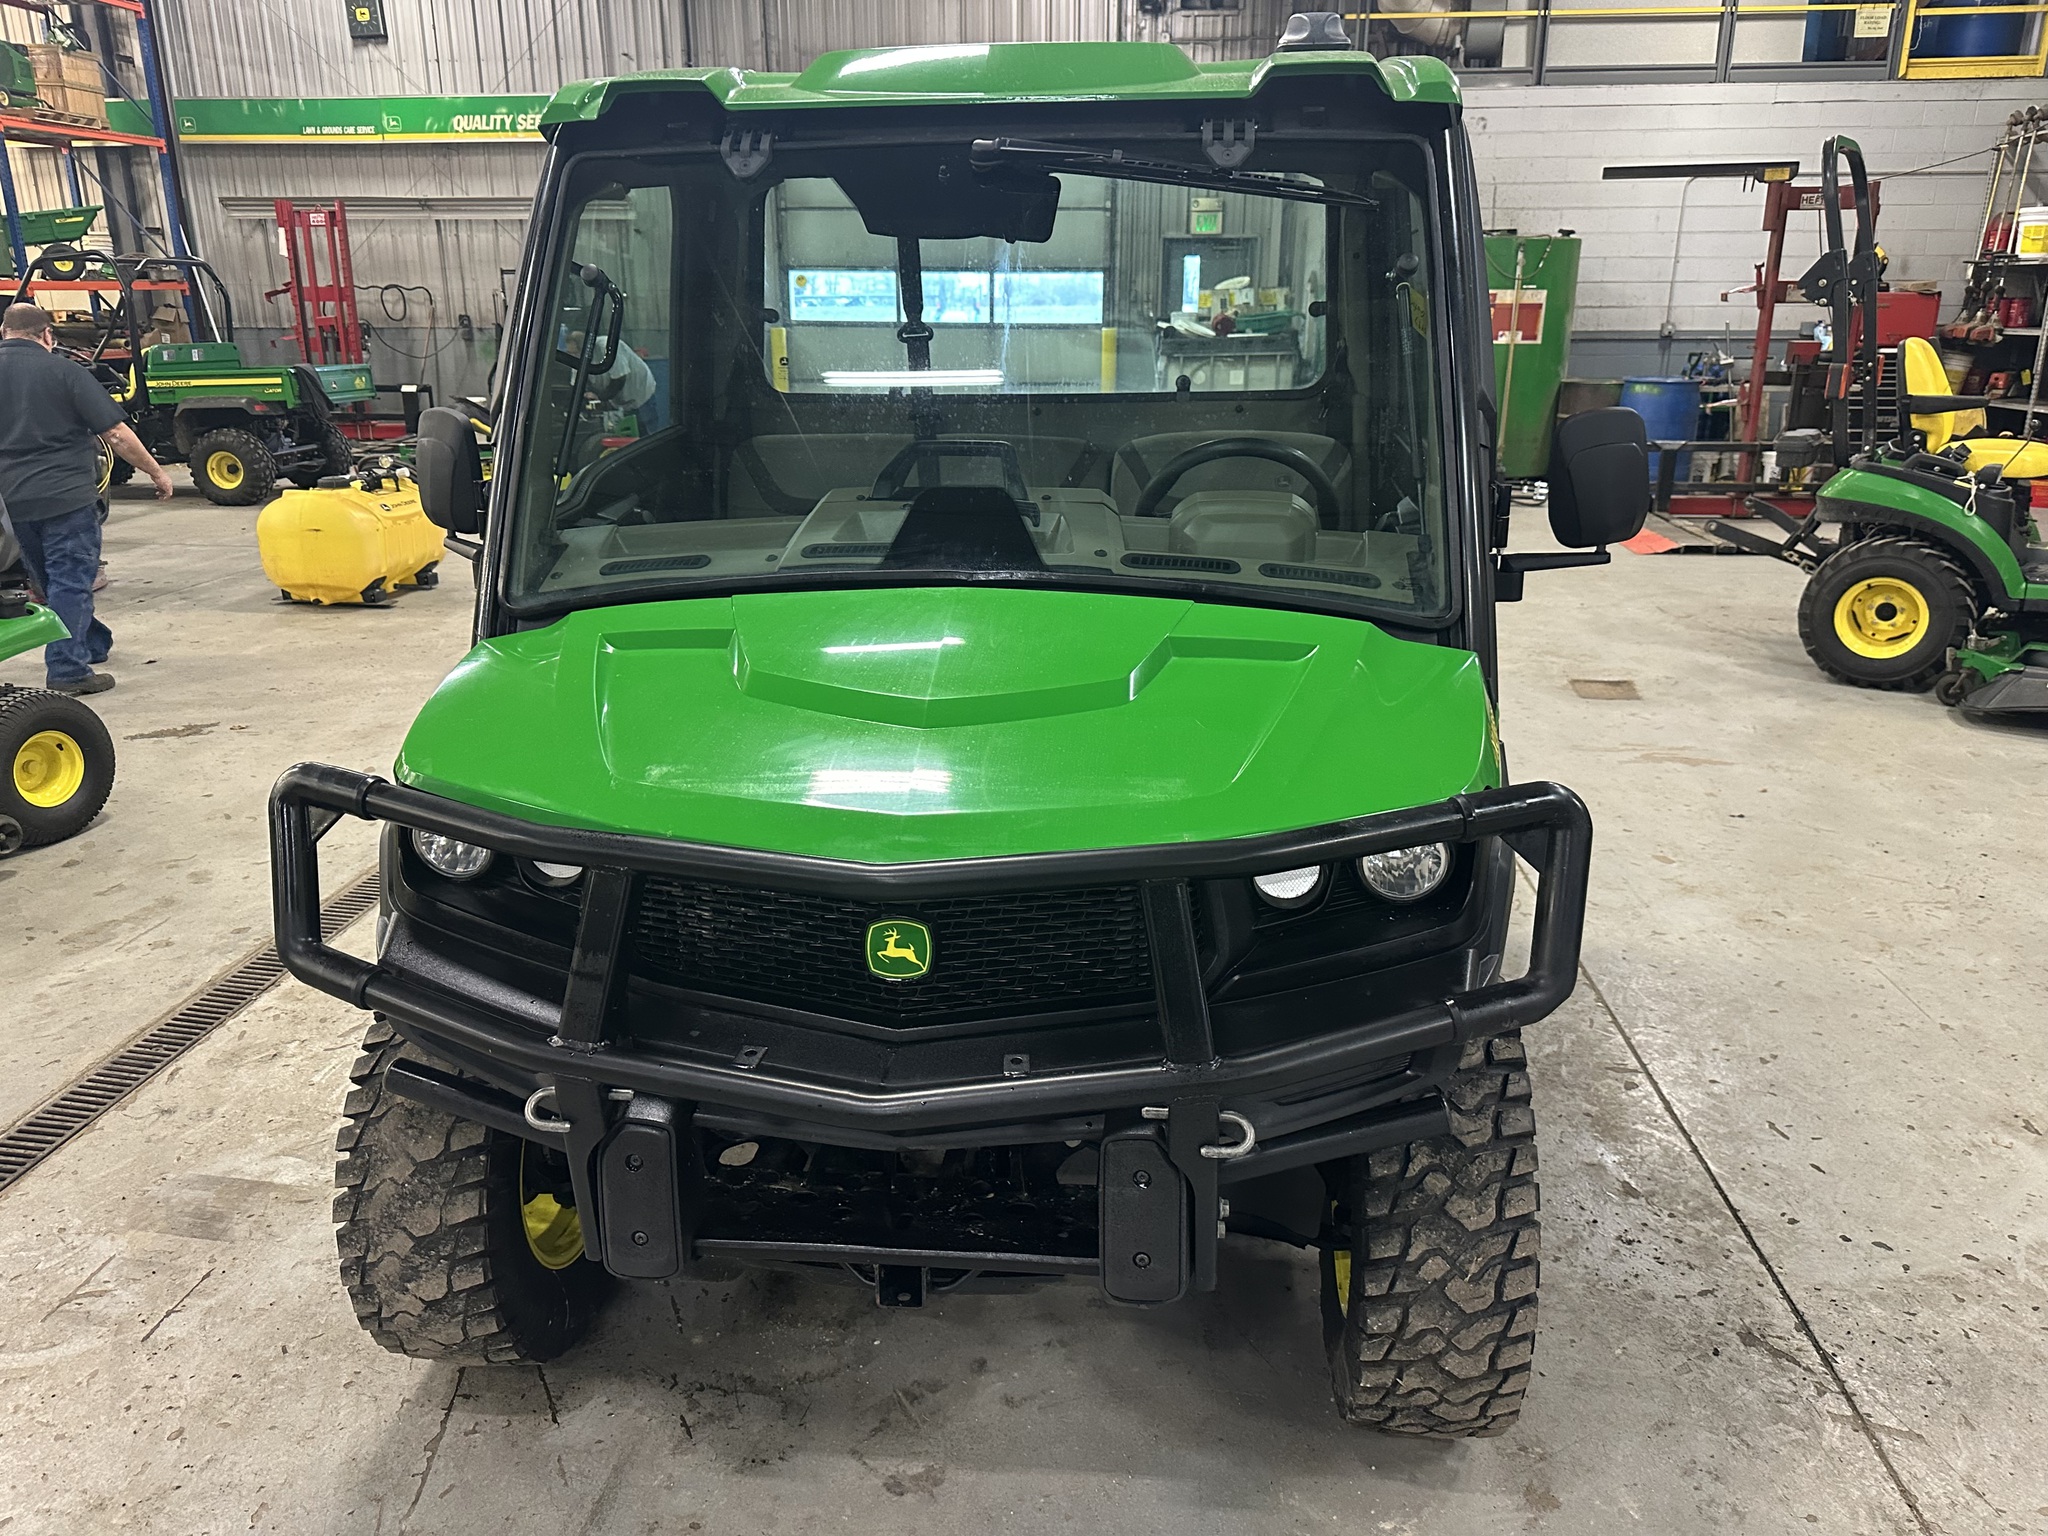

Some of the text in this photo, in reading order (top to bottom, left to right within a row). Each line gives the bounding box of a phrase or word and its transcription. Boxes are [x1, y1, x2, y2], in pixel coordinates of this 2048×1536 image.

[302, 125, 376, 135] LAWN & GROUNDS CARE SERVICE
[453, 114, 514, 133] QUALITY
[1196, 214, 1217, 231] EXIT
